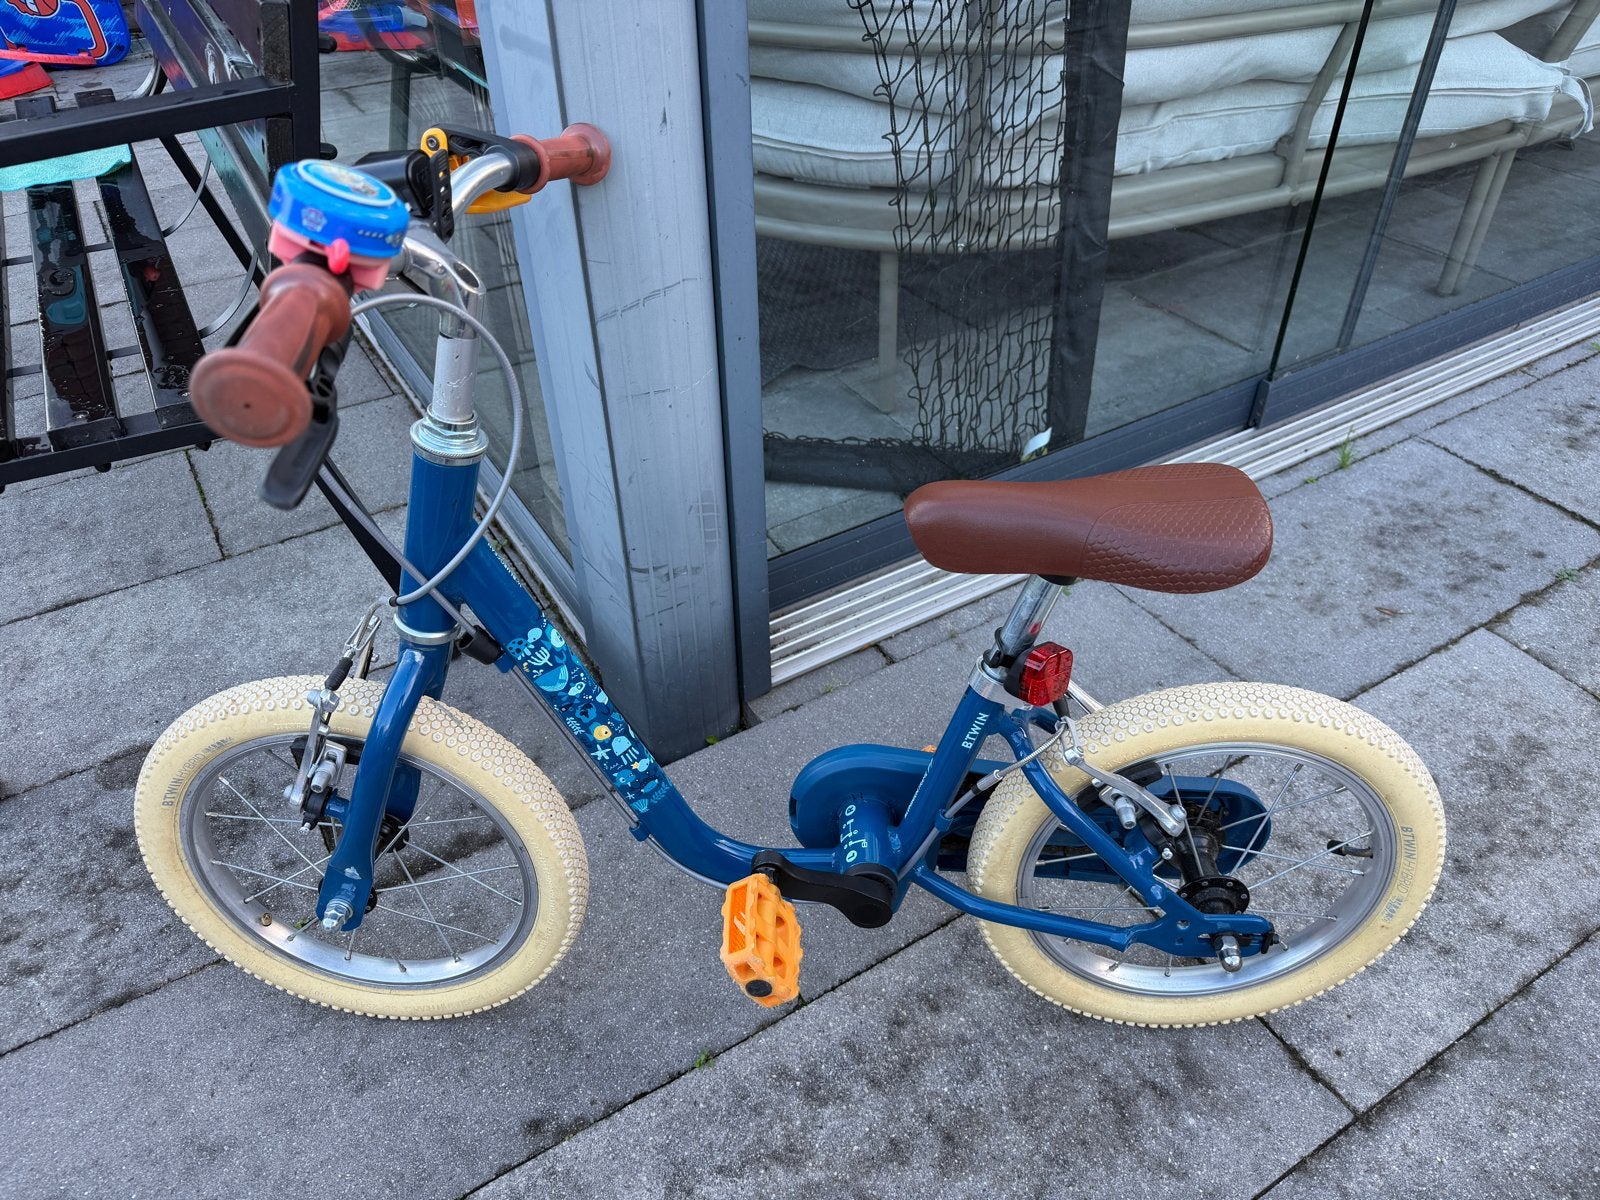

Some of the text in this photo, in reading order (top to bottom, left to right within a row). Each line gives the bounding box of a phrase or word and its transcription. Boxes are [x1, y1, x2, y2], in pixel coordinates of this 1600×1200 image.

[961, 712, 990, 750] BTWIN
[162, 753, 205, 806] BTWIN HYBRID
[1397, 826, 1416, 893] BTWIN HYBRID
